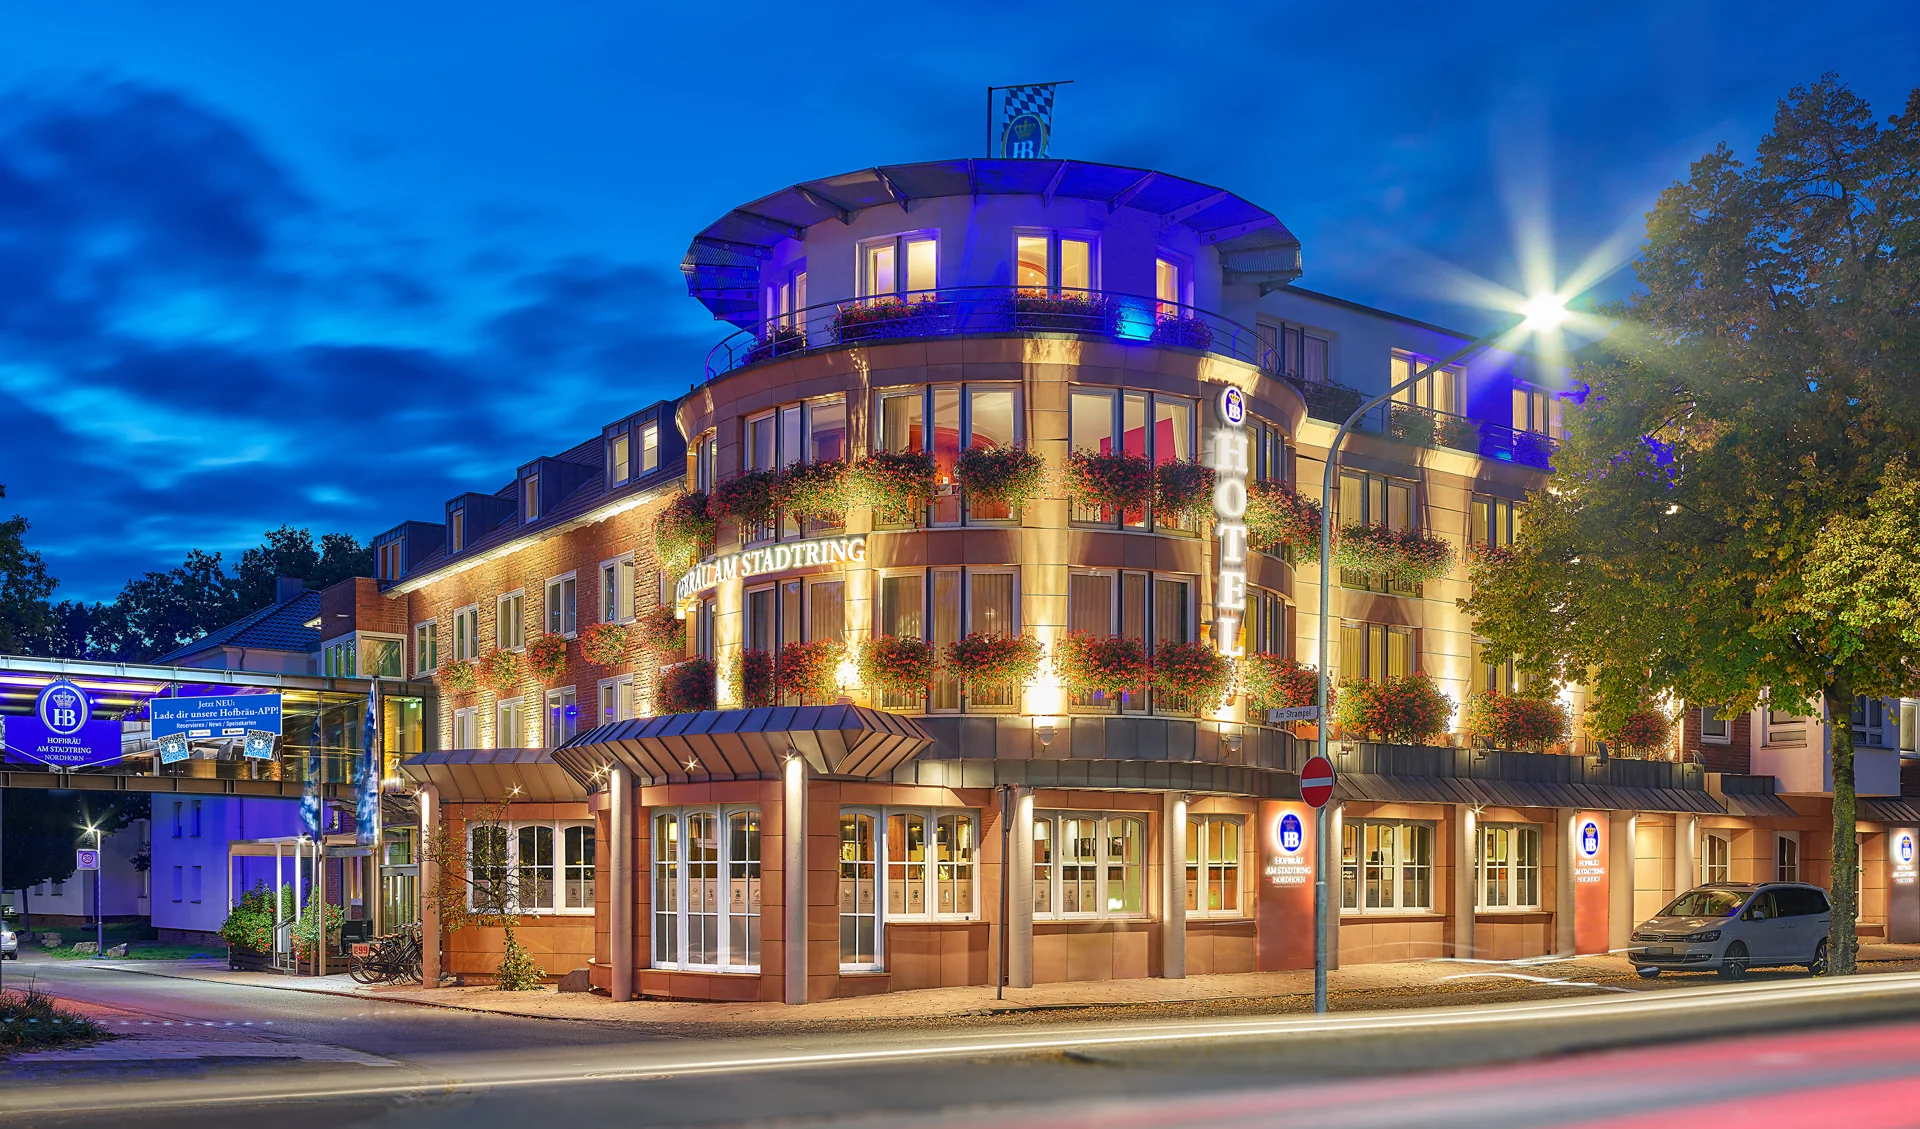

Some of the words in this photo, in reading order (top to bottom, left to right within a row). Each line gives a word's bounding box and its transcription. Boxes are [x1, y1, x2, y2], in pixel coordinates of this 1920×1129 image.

[1013, 140, 1034, 158] HB
[1229, 403, 1240, 420] HB
[1215, 433, 1248, 657] HOTEL
[713, 556, 738, 584] AM
[740, 539, 866, 577] STADTRING
[198, 701, 214, 709] Jetzt
[215, 699, 235, 707] NEU:
[53, 708, 76, 726] HB
[154, 711, 174, 720] Lade
[176, 710, 189, 719] dir
[220, 706, 279, 717] Hofbräu-APP!
[1275, 711, 1284, 719] Am
[1286, 709, 1312, 718] Strampel
[47, 736, 81, 744] HOFBRÄU
[37, 745, 49, 753] AM
[50, 746, 92, 754] STADTRING
[44, 754, 84, 762] NORDHORN
[1283, 831, 1300, 848] HB
